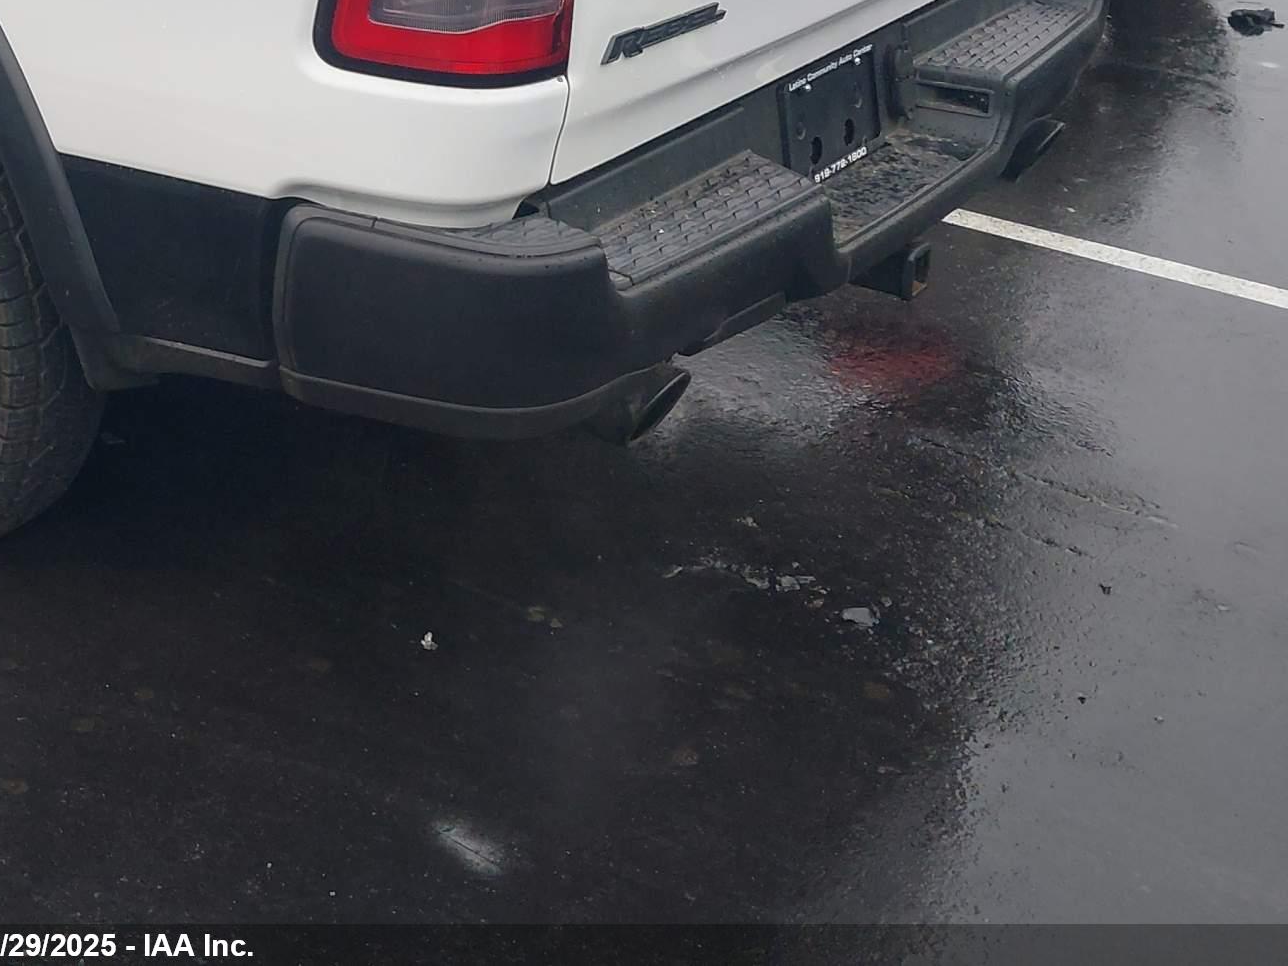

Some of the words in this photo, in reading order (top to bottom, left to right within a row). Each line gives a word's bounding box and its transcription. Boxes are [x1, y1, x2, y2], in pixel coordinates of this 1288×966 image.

[788, 77, 807, 92] Latino
[807, 60, 838, 82] Community
[839, 53, 853, 66] Auto
[853, 43, 873, 58] Center
